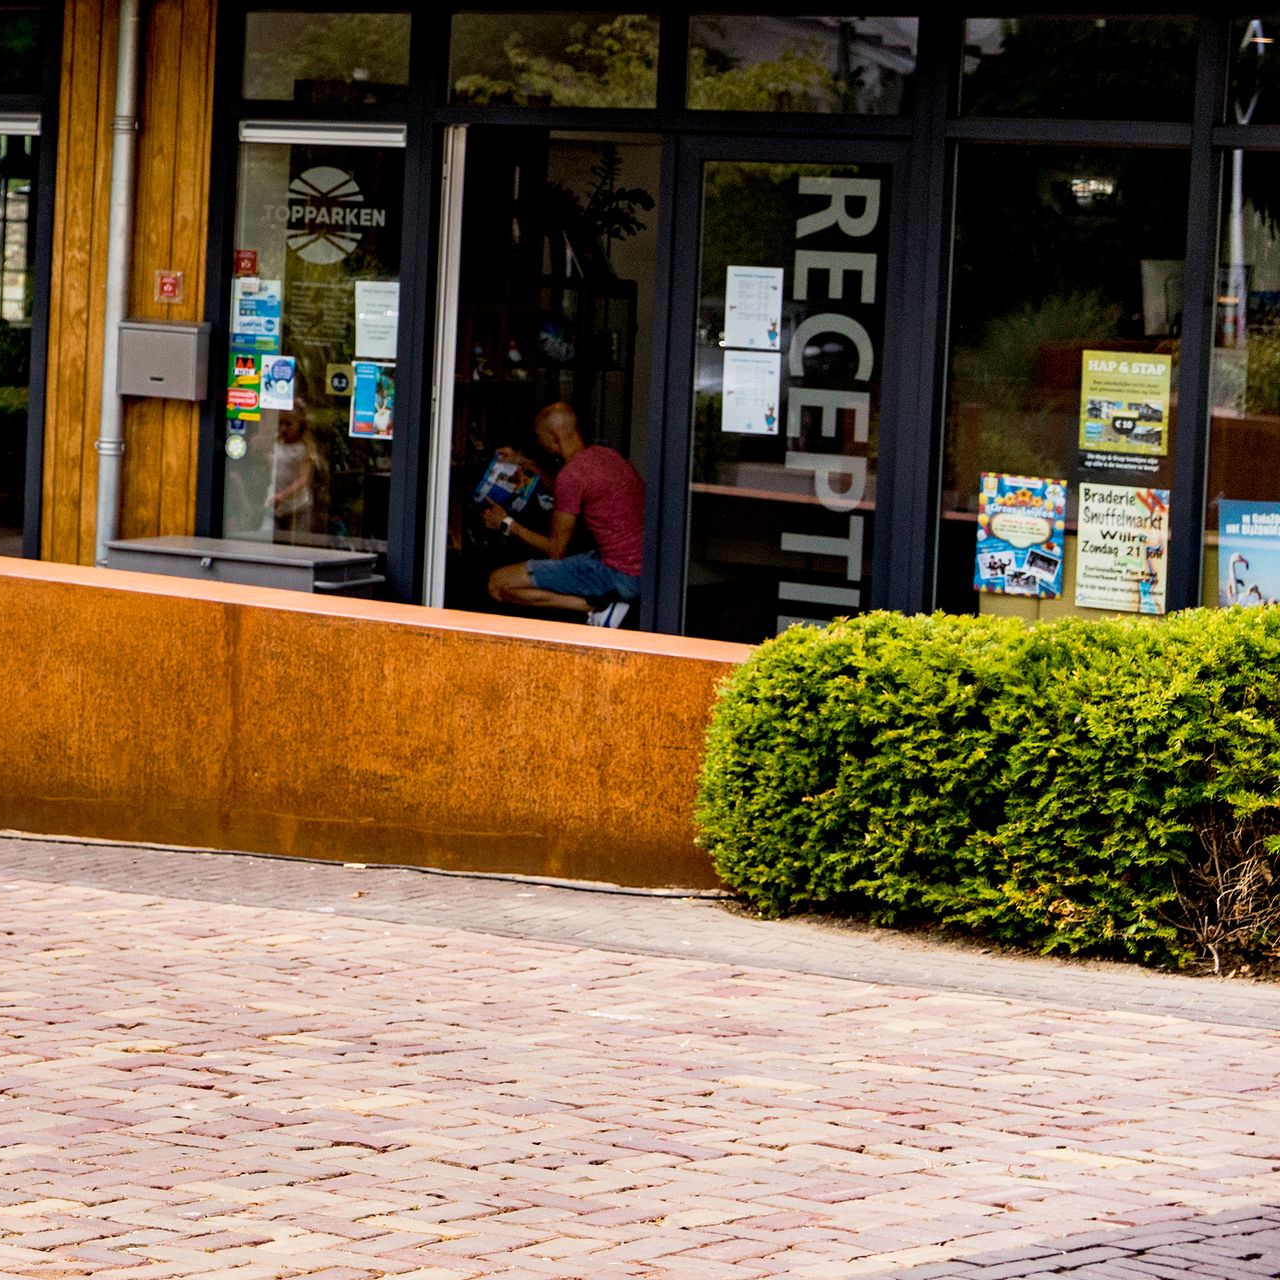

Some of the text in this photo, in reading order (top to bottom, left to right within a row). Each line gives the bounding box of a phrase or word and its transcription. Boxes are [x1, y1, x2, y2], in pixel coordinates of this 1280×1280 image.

[263, 205, 386, 227] TOPPARKEN
[1087, 359, 1166, 375] HAP & STAP
[777, 176, 881, 632] RECEPTI
[1083, 488, 1136, 506] Braderie
[1083, 506, 1163, 530] Snuffelmarkt
[1081, 540, 1119, 557] Zondag
[1126, 546, 1140, 557] 21
